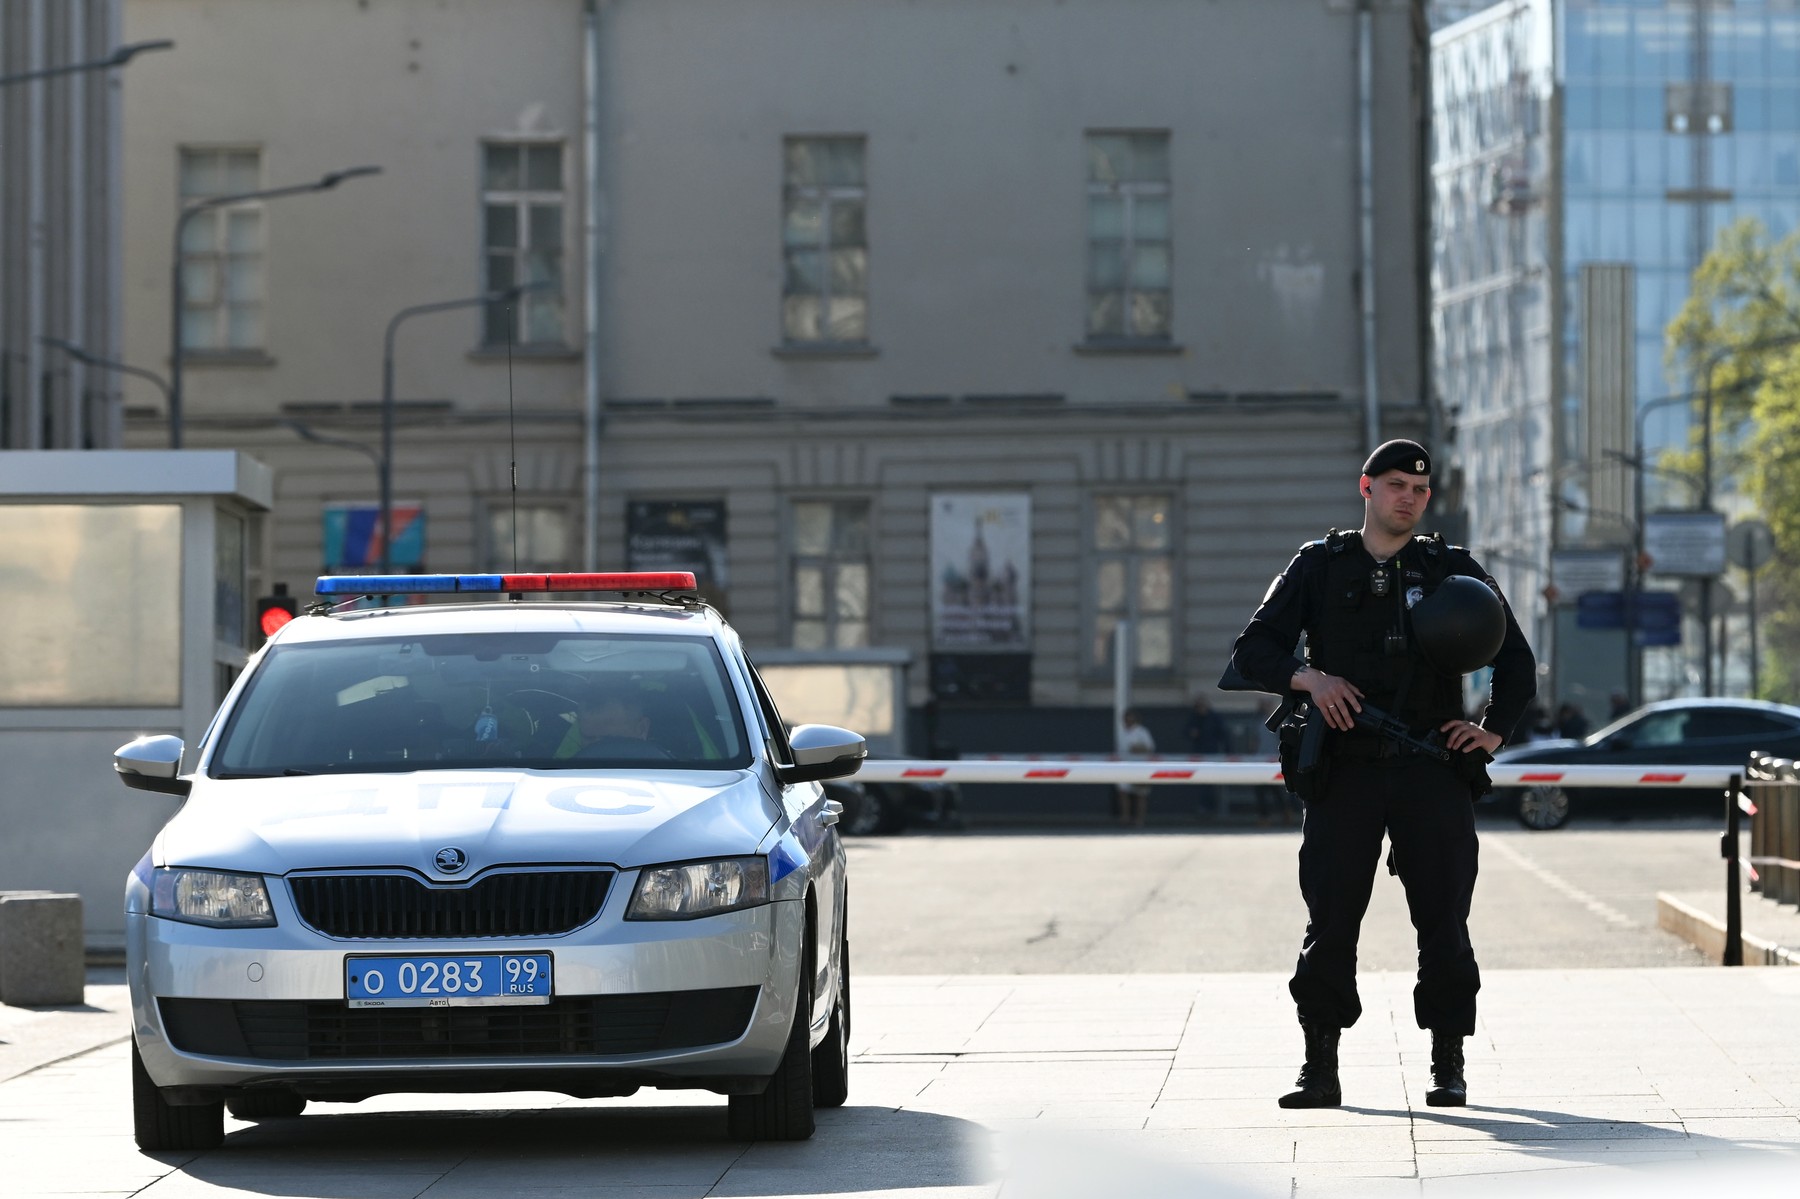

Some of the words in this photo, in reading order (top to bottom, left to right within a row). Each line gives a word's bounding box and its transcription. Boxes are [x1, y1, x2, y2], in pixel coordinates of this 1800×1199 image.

[260, 782, 656, 826] ДПС
[399, 961, 483, 994] 0283
[505, 958, 538, 983] 99
[510, 984, 534, 993] RUS
